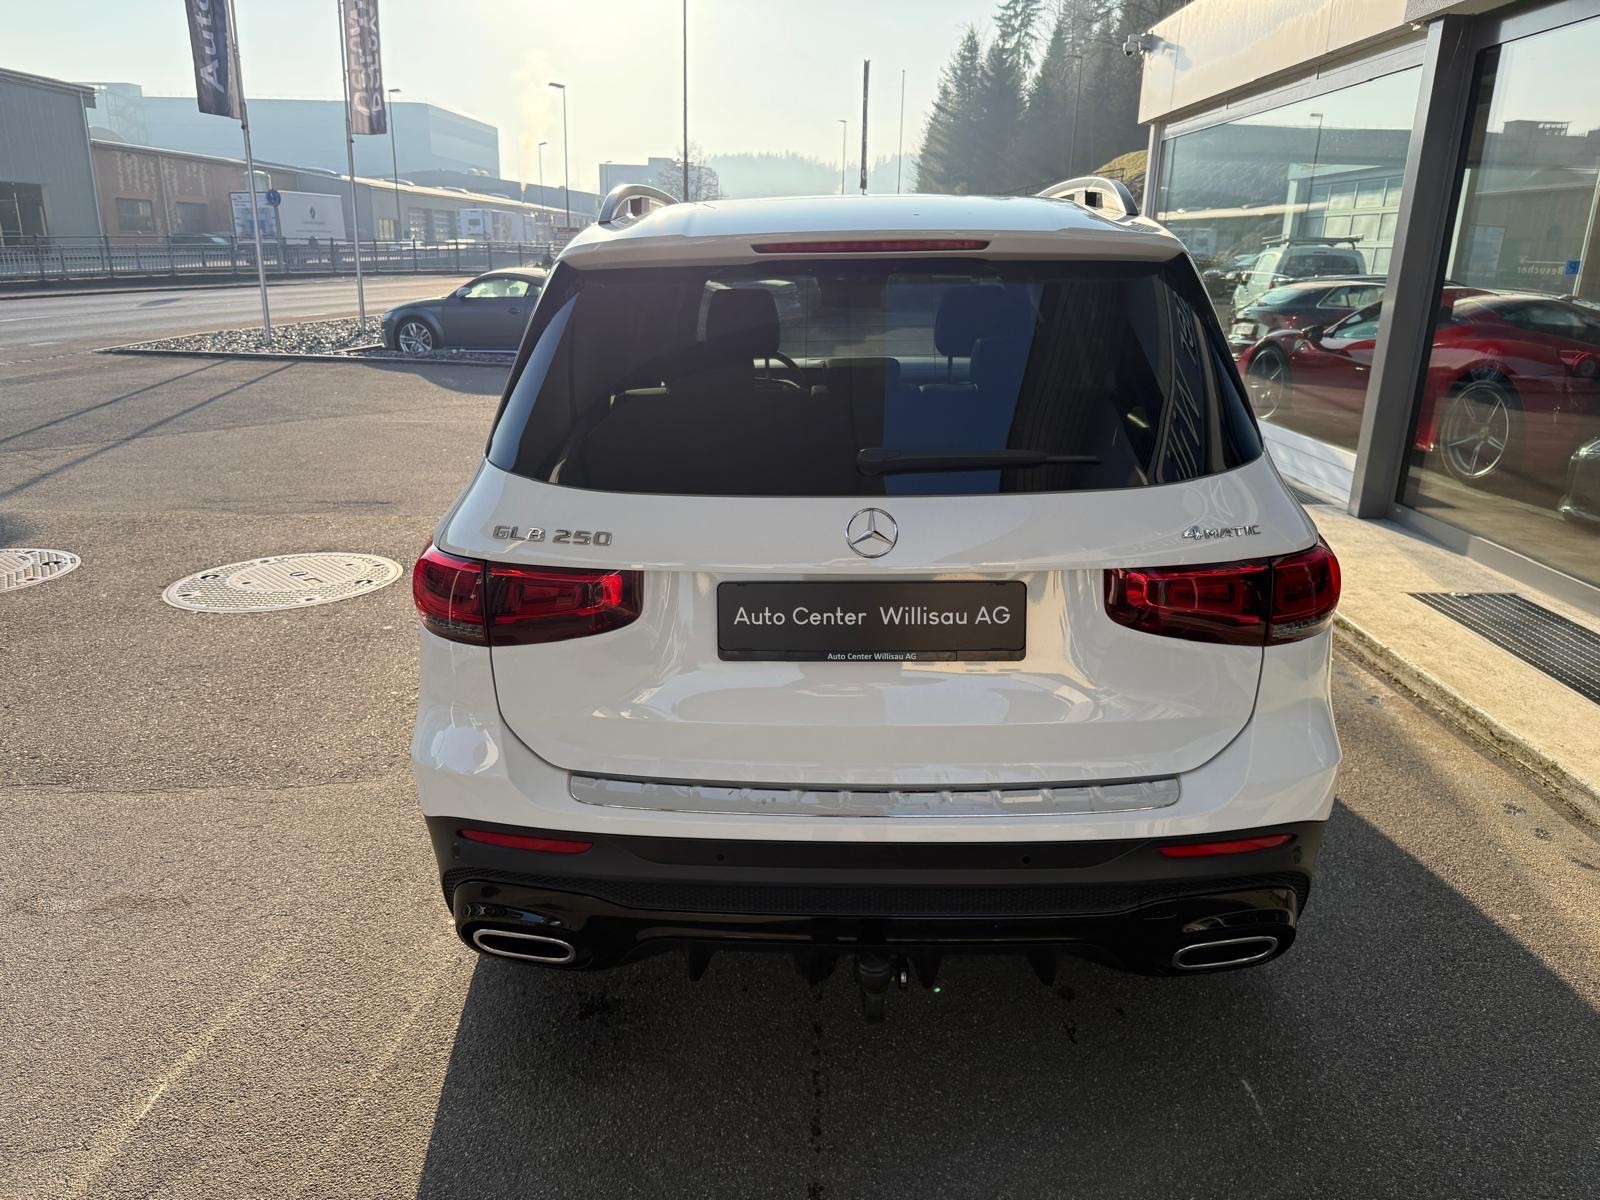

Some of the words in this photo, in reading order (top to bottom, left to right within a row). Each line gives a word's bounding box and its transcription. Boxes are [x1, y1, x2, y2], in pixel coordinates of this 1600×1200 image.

[492, 525, 546, 542] GLB
[552, 529, 613, 546] 250
[1182, 525, 1262, 541] 4MATIC
[733, 606, 786, 626] Auto
[792, 606, 867, 626] Center
[879, 606, 968, 626] Willisau
[974, 606, 1011, 625] AG
[827, 652, 846, 660] Auto
[847, 652, 872, 660] Center
[873, 652, 904, 660] Willisau
[905, 652, 917, 660] AG
